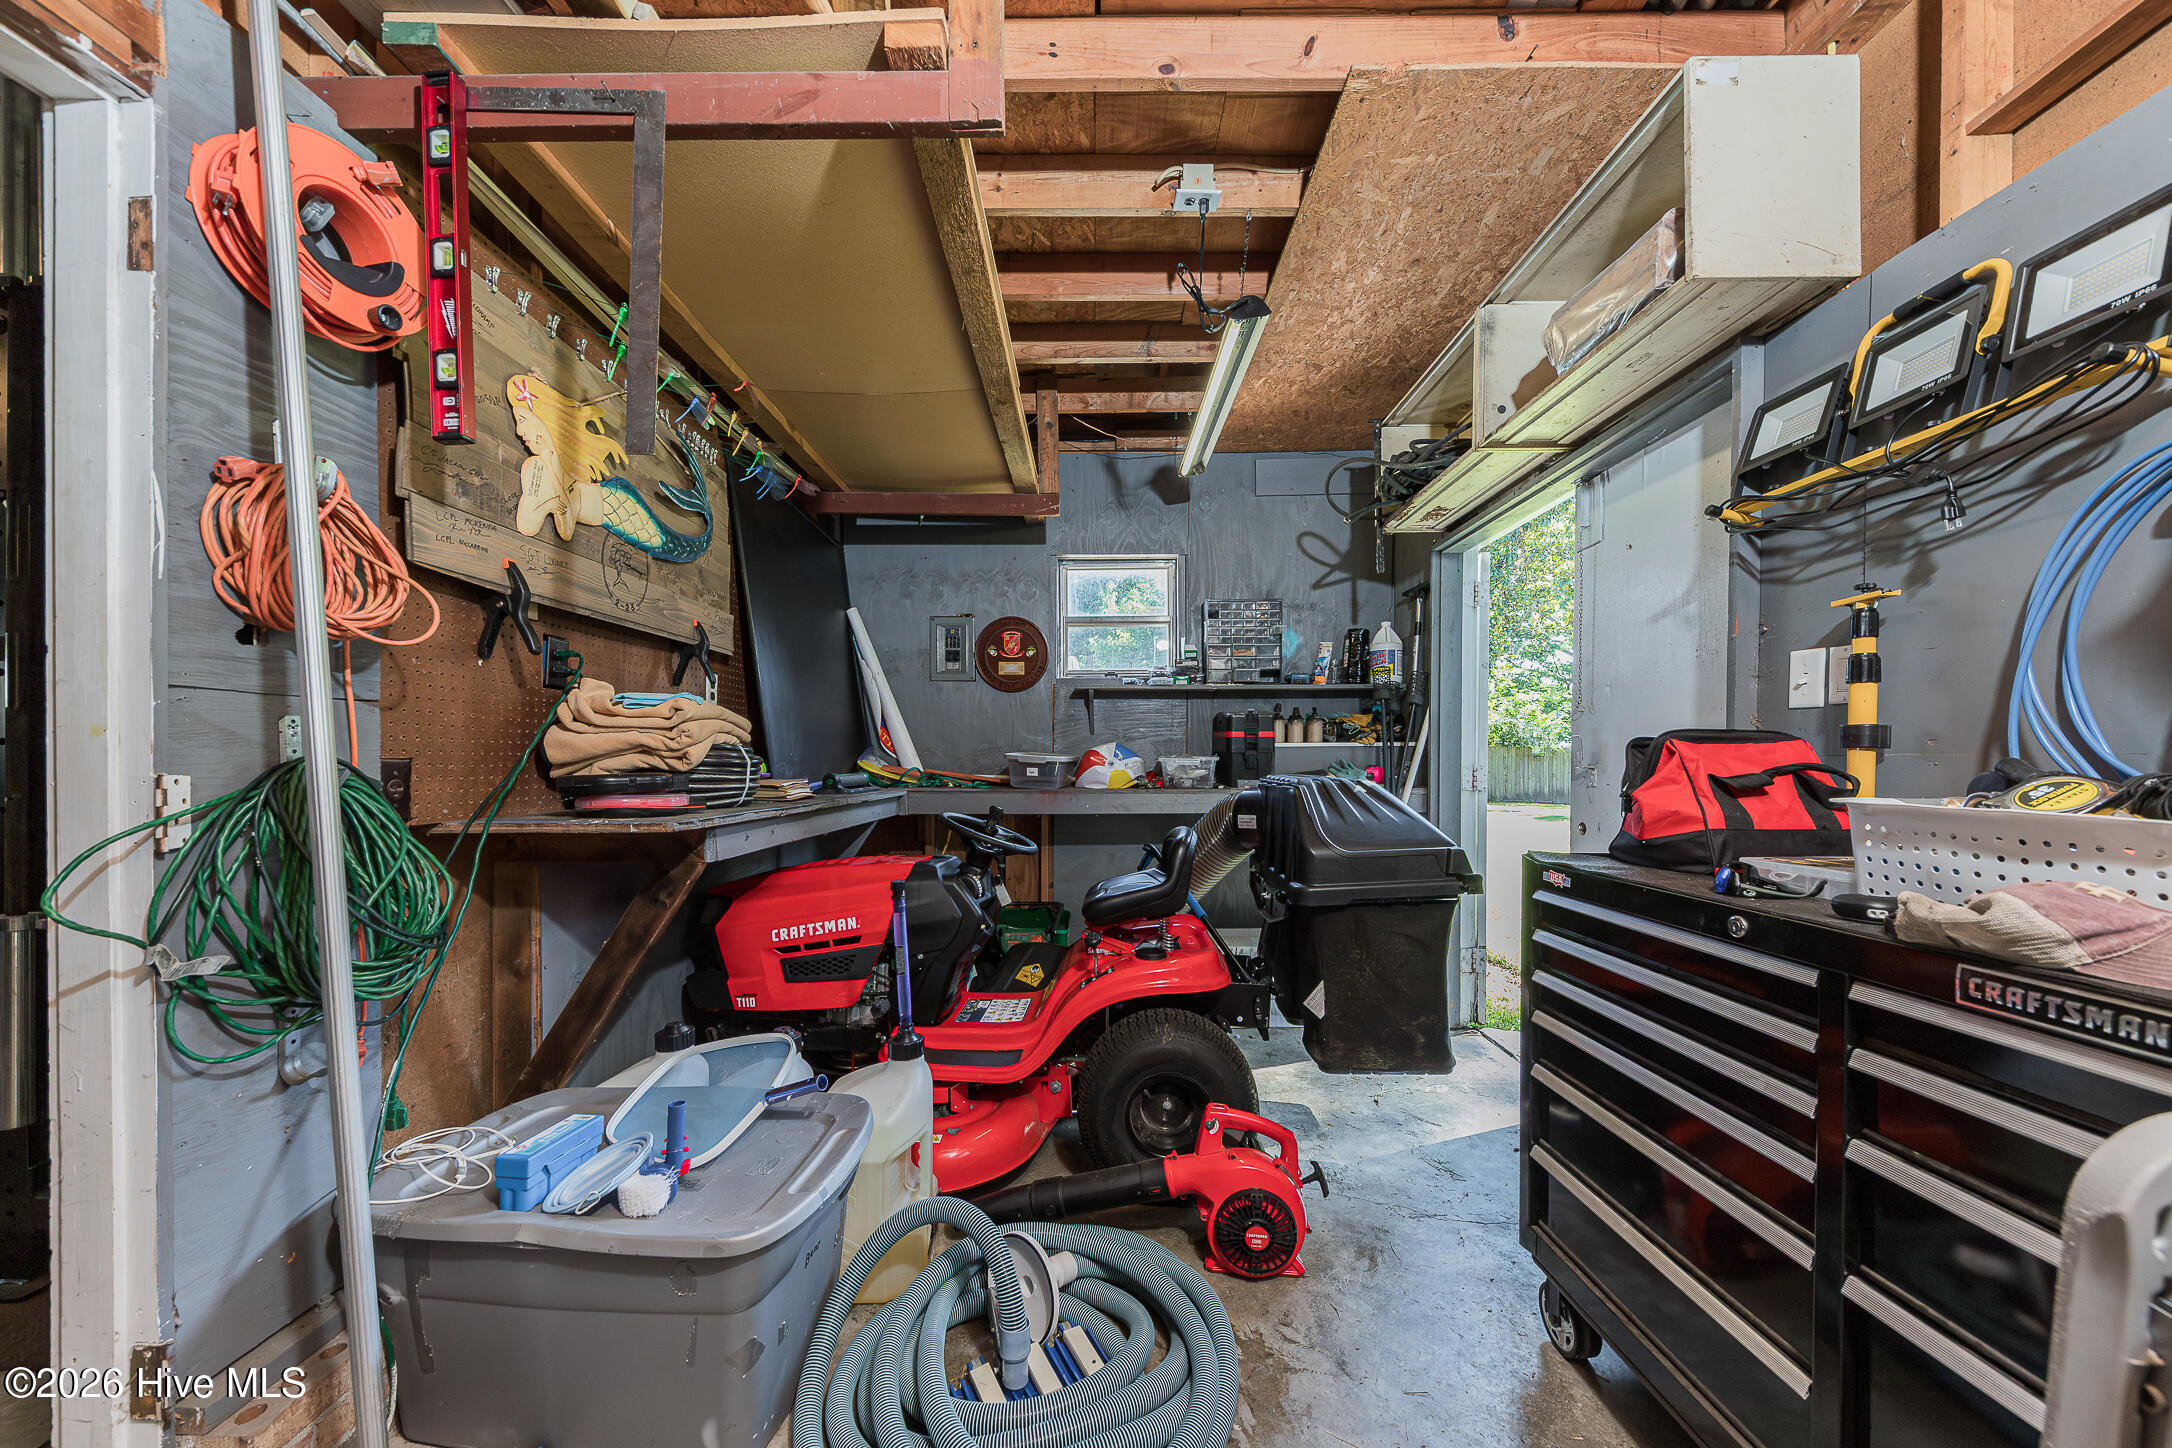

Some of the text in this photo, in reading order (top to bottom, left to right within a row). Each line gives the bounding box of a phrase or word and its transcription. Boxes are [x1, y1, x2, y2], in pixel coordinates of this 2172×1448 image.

[2111, 283, 2158, 309] 70W IP66
[440, 297, 457, 339] Milwaukee
[1921, 373, 1952, 392] 70W IP66
[519, 544, 541, 564] SGT
[771, 916, 857, 943] CRAFTSMAN
[736, 997, 756, 1008] T110
[1968, 976, 2172, 1050] CRAFTSMAN
